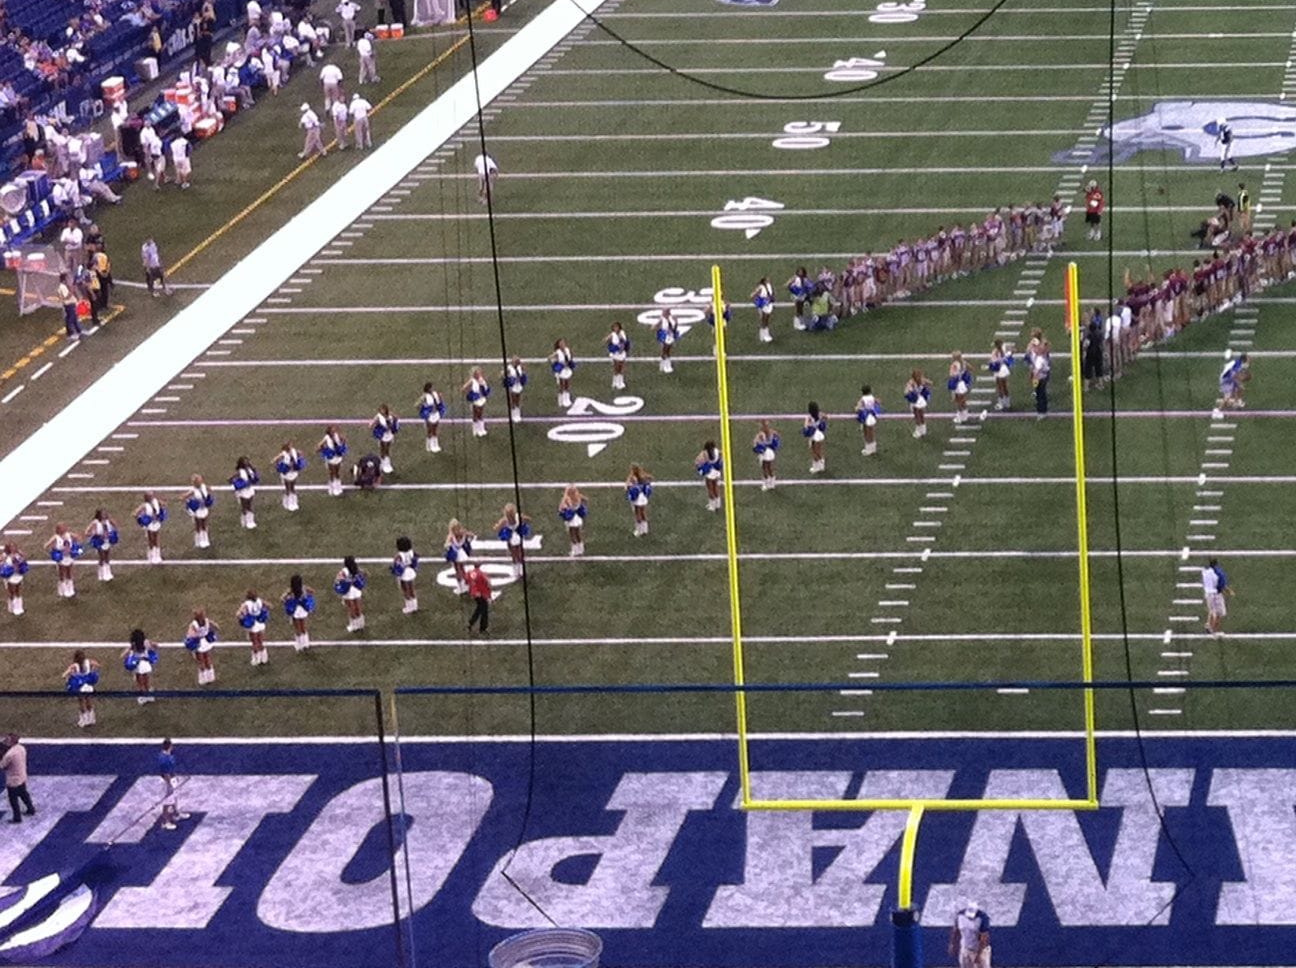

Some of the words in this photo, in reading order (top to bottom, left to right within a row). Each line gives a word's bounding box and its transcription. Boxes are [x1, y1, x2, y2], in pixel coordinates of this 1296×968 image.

[772, 121, 841, 149] 50
[710, 196, 785, 230] 40
[547, 396, 645, 443] 20
